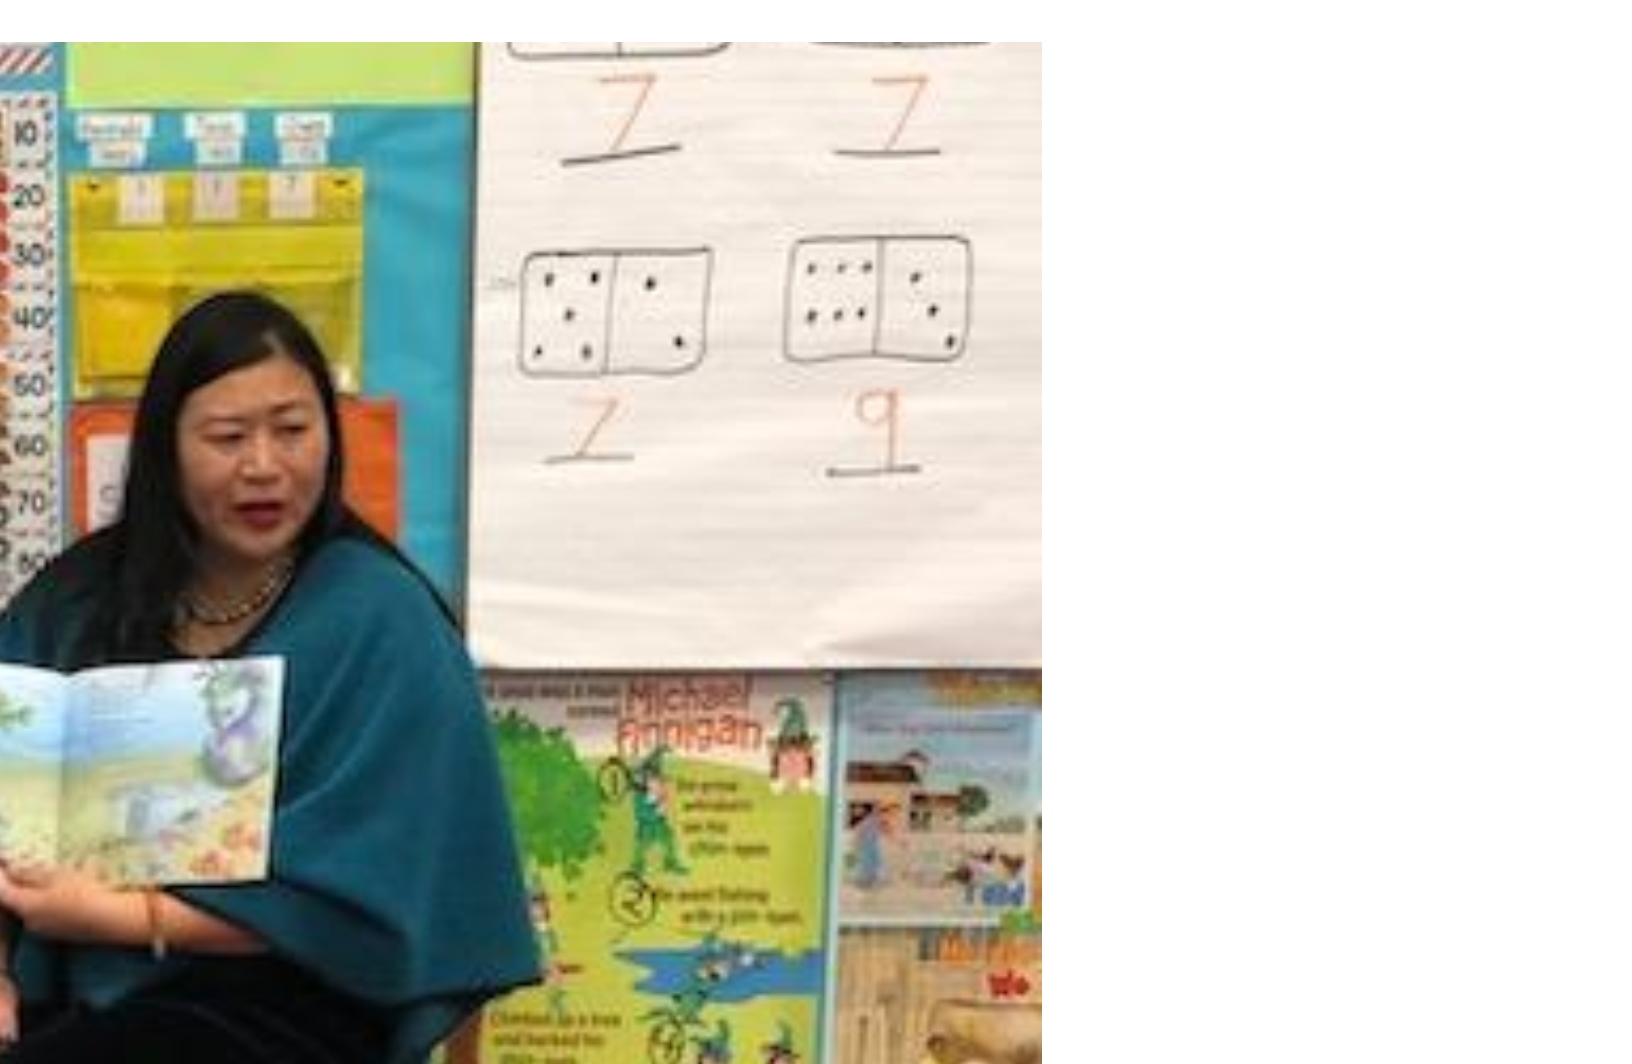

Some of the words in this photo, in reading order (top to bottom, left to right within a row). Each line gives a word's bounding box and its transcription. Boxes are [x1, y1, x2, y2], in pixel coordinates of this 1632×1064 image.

[596, 72, 658, 152] 7
[870, 73, 929, 150] 7
[15, 118, 38, 146] 10
[14, 180, 46, 208] 20
[14, 240, 47, 269] 30
[13, 303, 47, 332] 40
[14, 371, 48, 398] 50
[566, 397, 621, 458] 7
[854, 389, 901, 471] 9
[15, 435, 48, 461] 60
[19, 488, 45, 515] 70
[626, 675, 754, 717] Michael
